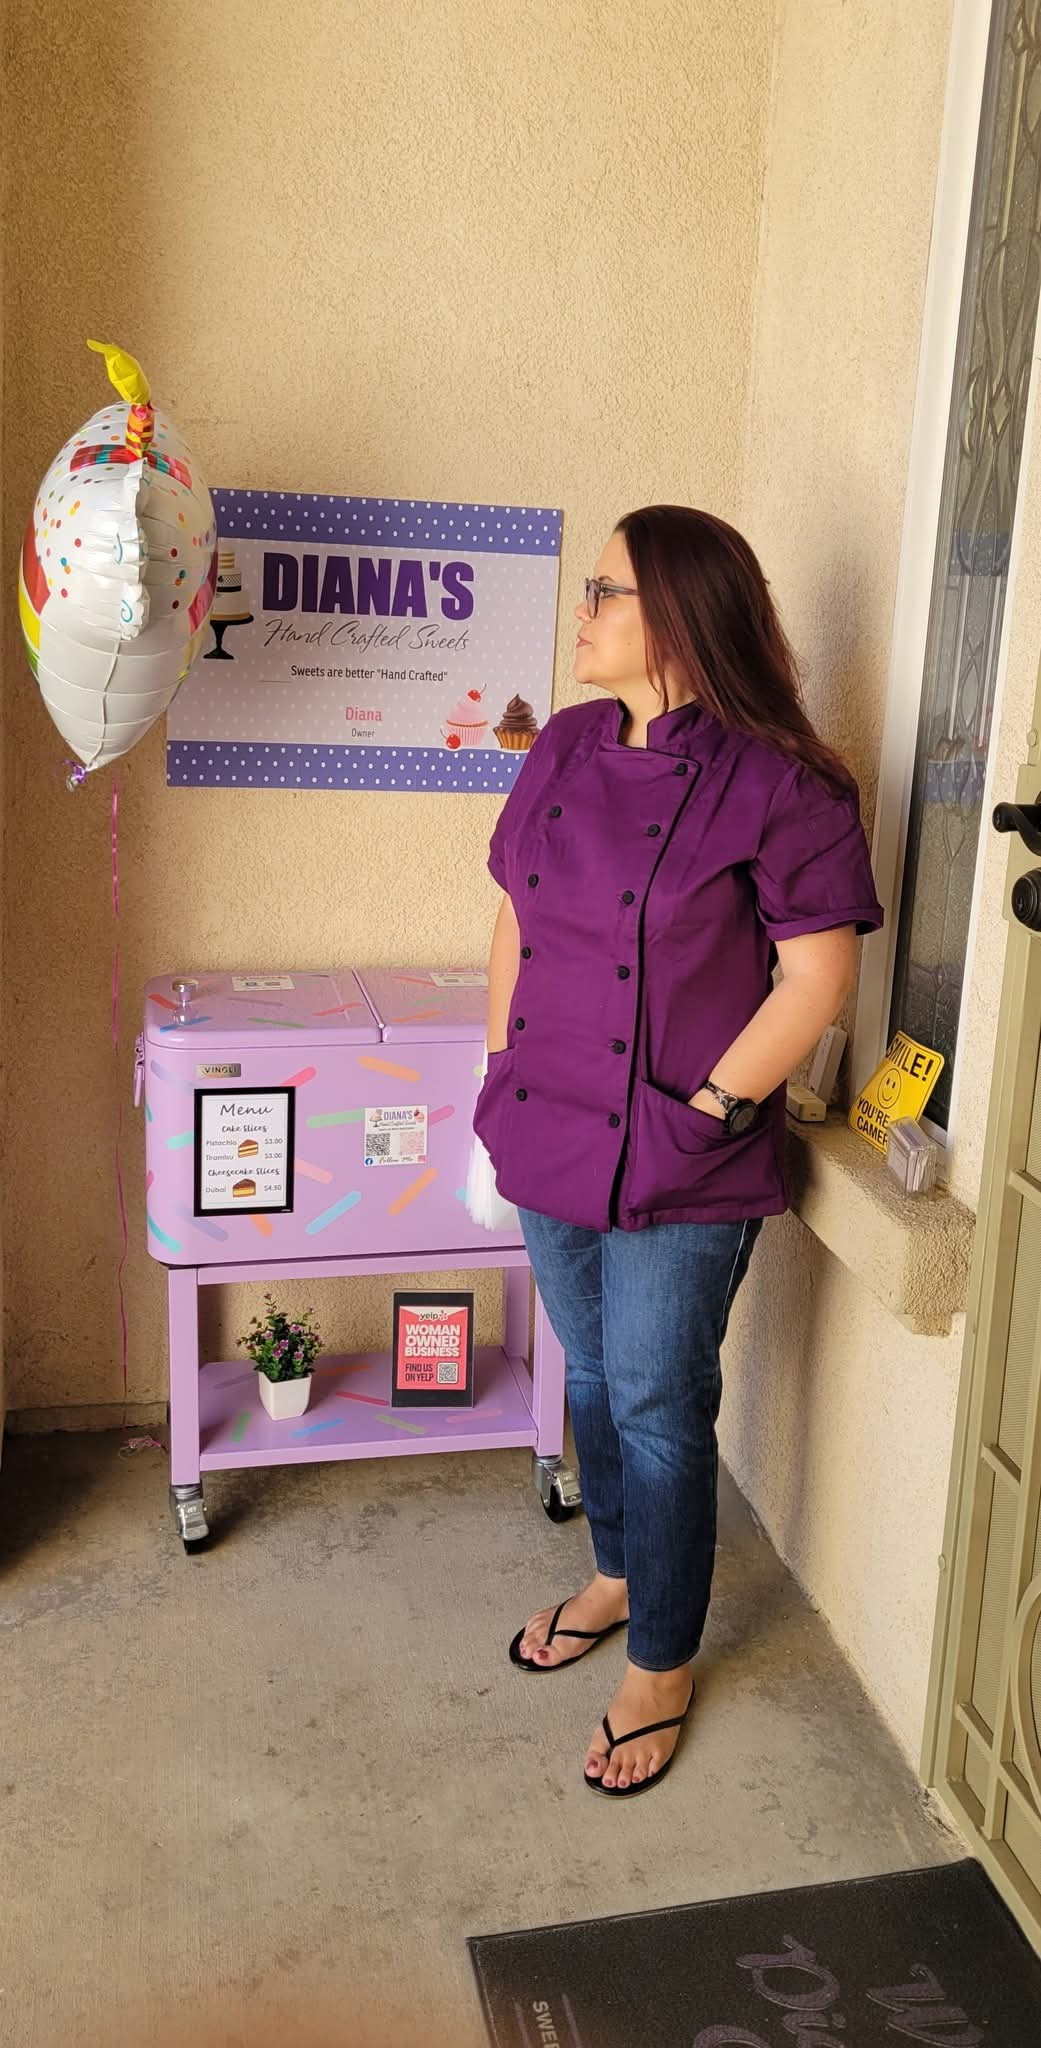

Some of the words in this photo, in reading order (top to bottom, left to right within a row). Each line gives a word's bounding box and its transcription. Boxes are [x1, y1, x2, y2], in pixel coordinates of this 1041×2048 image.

[262, 552, 474, 621] DIANA'S
[264, 618, 333, 648] Hand
[331, 620, 411, 654] Crafted
[408, 624, 470, 650] Sweets
[291, 665, 325, 678] Sweets
[327, 667, 343, 679] are
[345, 667, 374, 680] better
[377, 668, 406, 681] "Hand
[408, 669, 448, 682] Crafted"
[345, 706, 383, 722] Diana
[351, 727, 375, 739] Owner
[885, 1038, 934, 1082] SMILE!
[220, 1103, 274, 1117] Menu
[383, 1110, 413, 1121] DIANA'S
[857, 1096, 890, 1130] YOU'RE
[222, 1125, 242, 1133] Cake
[243, 1124, 268, 1133] Slices
[206, 1139, 237, 1147] Pistachio
[206, 1153, 234, 1161] Tiramisu
[264, 1152, 283, 1160] $3.00
[208, 1167, 254, 1177] Cheesecake
[256, 1167, 280, 1176] Slices
[420, 1311, 439, 1321] yelp
[405, 1323, 461, 1336] WOMAN
[404, 1335, 461, 1347] OWNED
[404, 1346, 460, 1357] BUSINESS
[405, 1362, 422, 1372] FIND
[423, 1363, 433, 1372] US
[405, 1373, 416, 1382] ON
[416, 1373, 434, 1382] YELP
